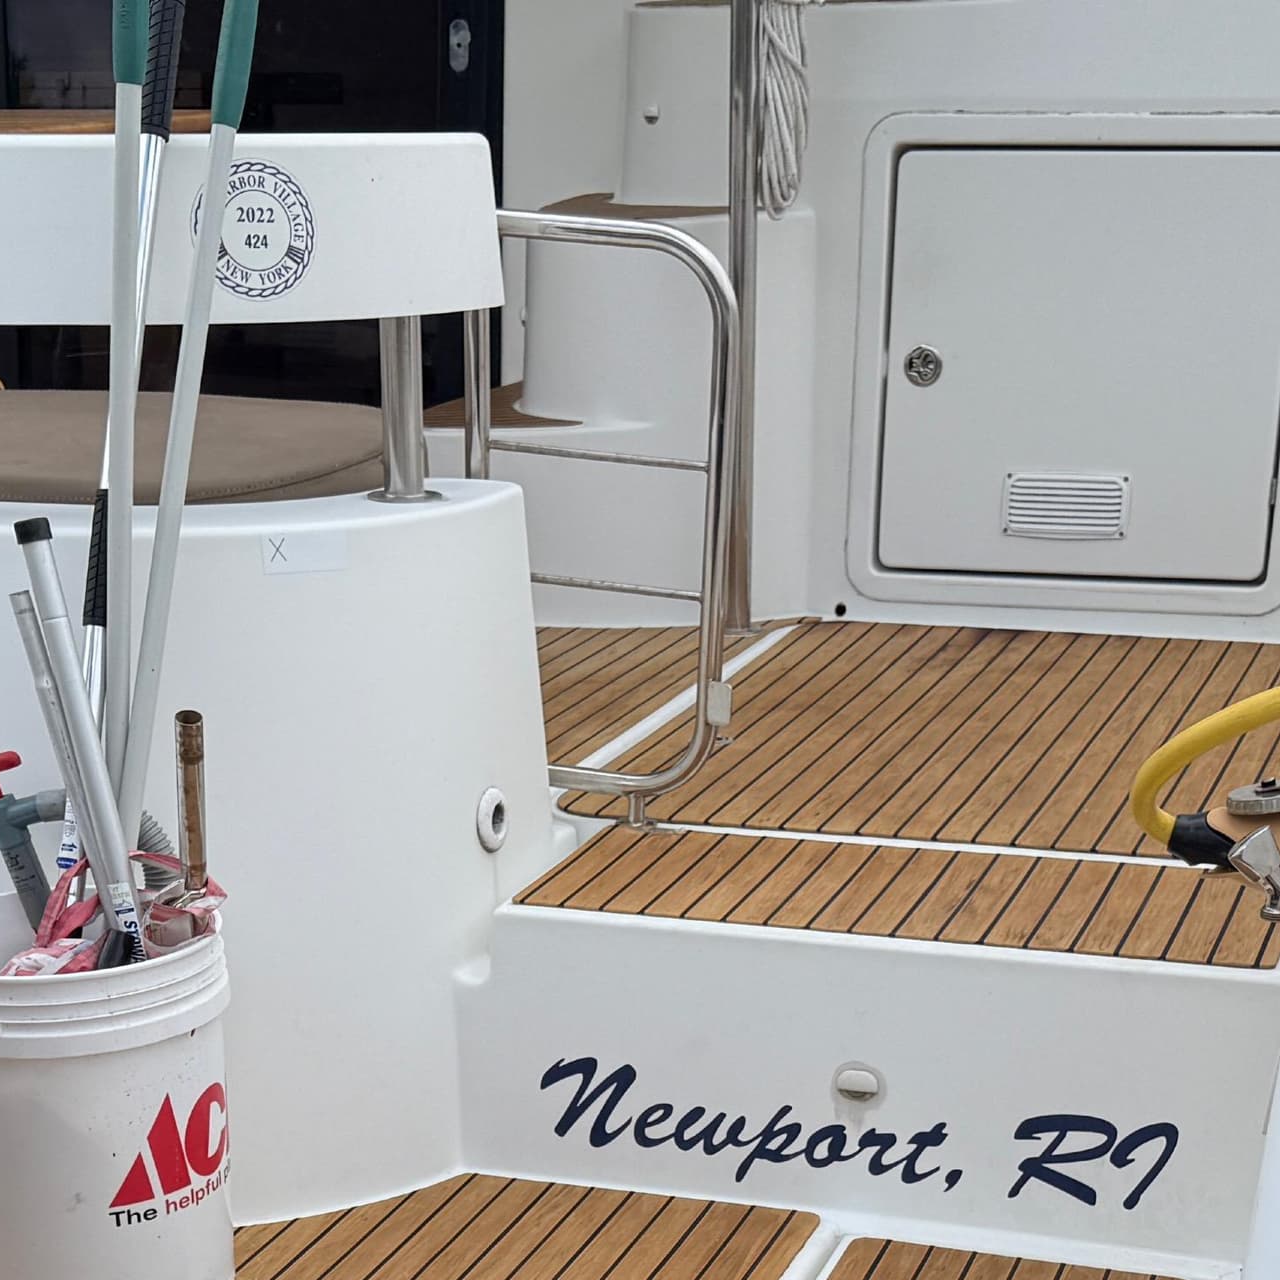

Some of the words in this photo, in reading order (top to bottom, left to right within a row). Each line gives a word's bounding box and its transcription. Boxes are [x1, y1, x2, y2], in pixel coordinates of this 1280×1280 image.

[227, 175, 265, 195] RBOR
[273, 182, 304, 243] VILLAGE
[236, 206, 275, 223] 2022
[245, 234, 268, 248] 424
[222, 259, 252, 284] NEW
[259, 261, 292, 285] YORK
[109, 1082, 230, 1208] AC
[540, 1057, 963, 1192] Newport,
[1008, 1114, 1179, 1210] RI
[109, 1207, 158, 1228] The
[166, 1171, 222, 1215] helpful
